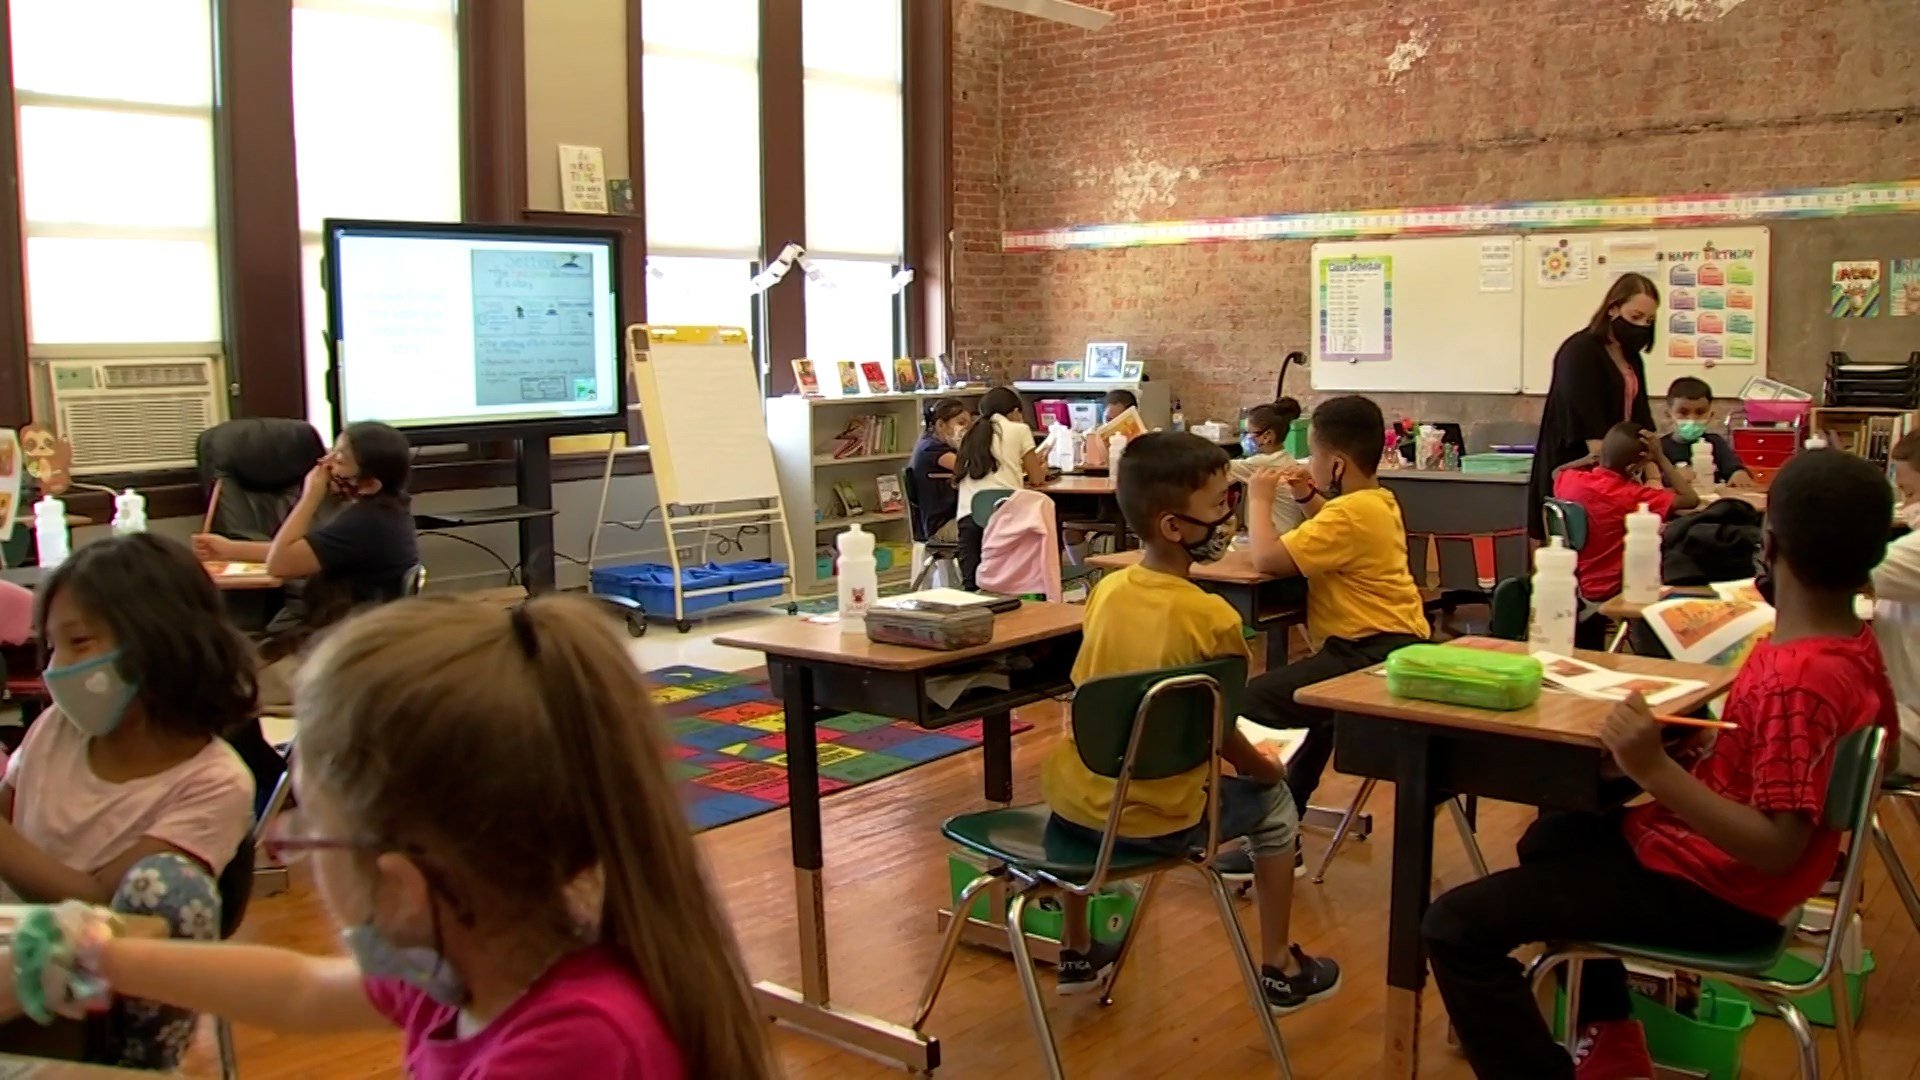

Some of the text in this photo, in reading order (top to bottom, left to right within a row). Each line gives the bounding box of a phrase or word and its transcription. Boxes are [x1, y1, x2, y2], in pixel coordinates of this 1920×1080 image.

[1668, 249, 1754, 261] HAPPY BIRTHDAY
[1261, 977, 1292, 993] TICA
